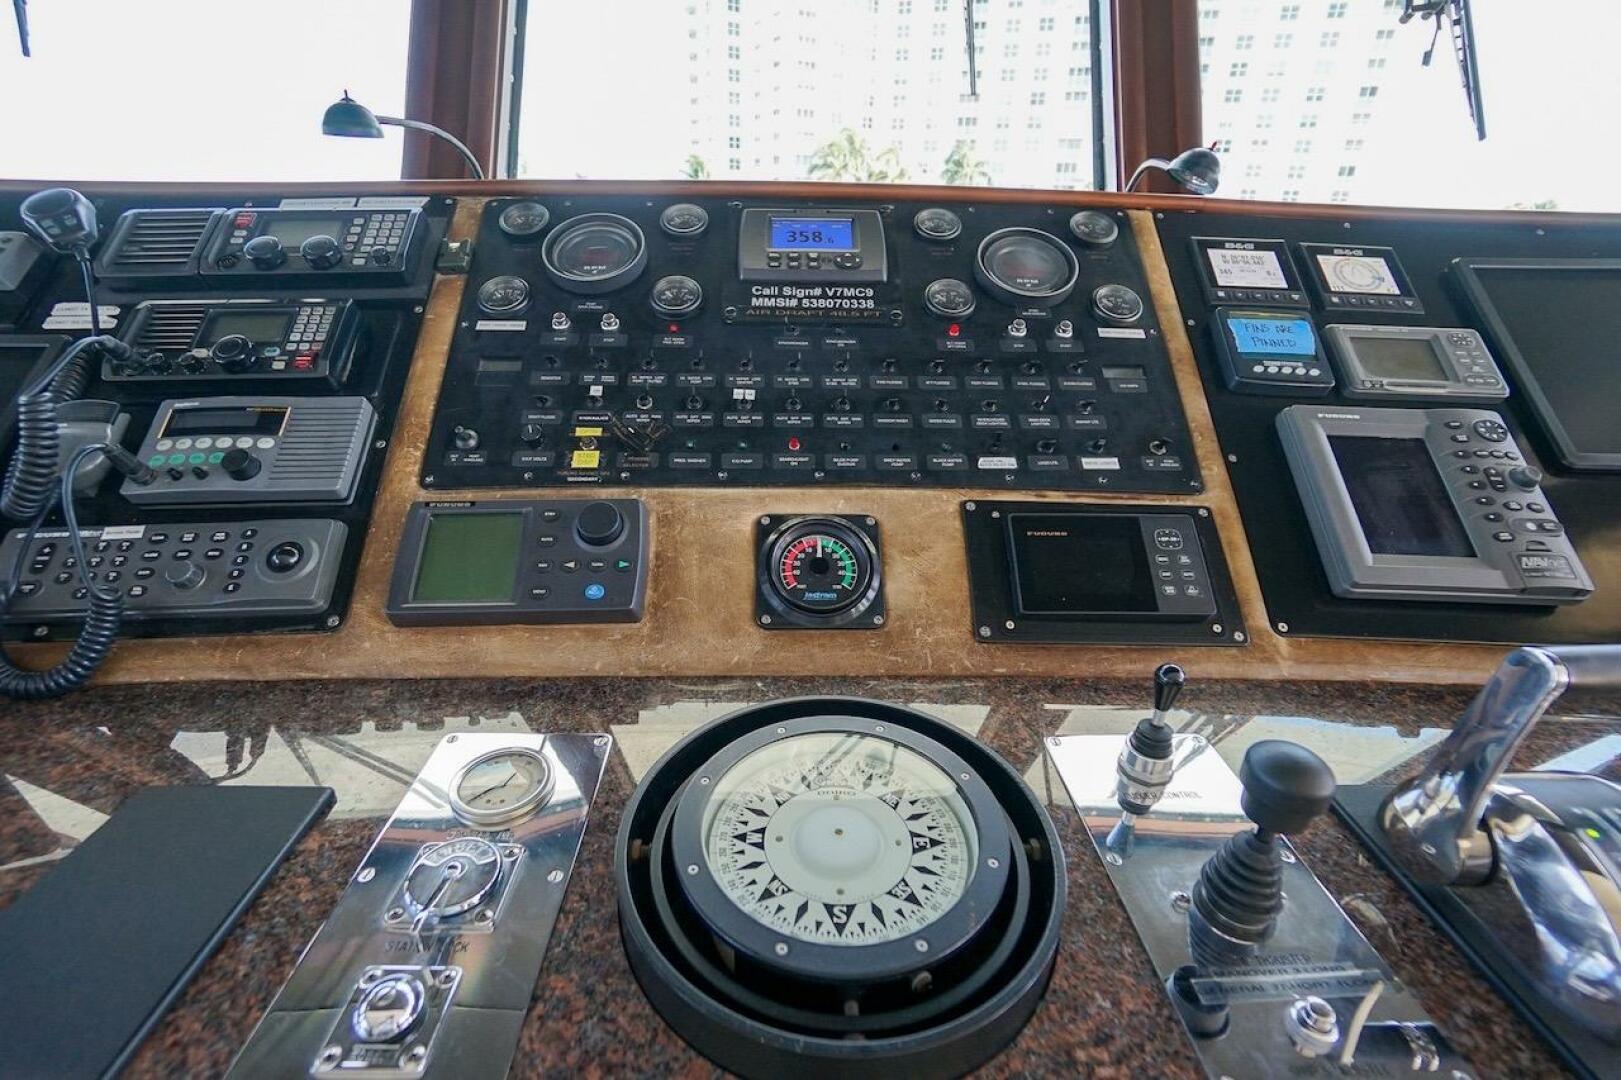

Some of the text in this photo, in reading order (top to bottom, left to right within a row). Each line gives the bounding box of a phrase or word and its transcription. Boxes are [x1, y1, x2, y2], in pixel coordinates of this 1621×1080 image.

[751, 285, 874, 298] Call Sign# V7MC9
[751, 297, 875, 309] MMSI# 538070338
[746, 308, 771, 316] AIR
[1245, 322, 1269, 334] FINS
[1251, 336, 1297, 348] PINNED
[913, 837, 929, 849] E
[832, 905, 849, 924] S
